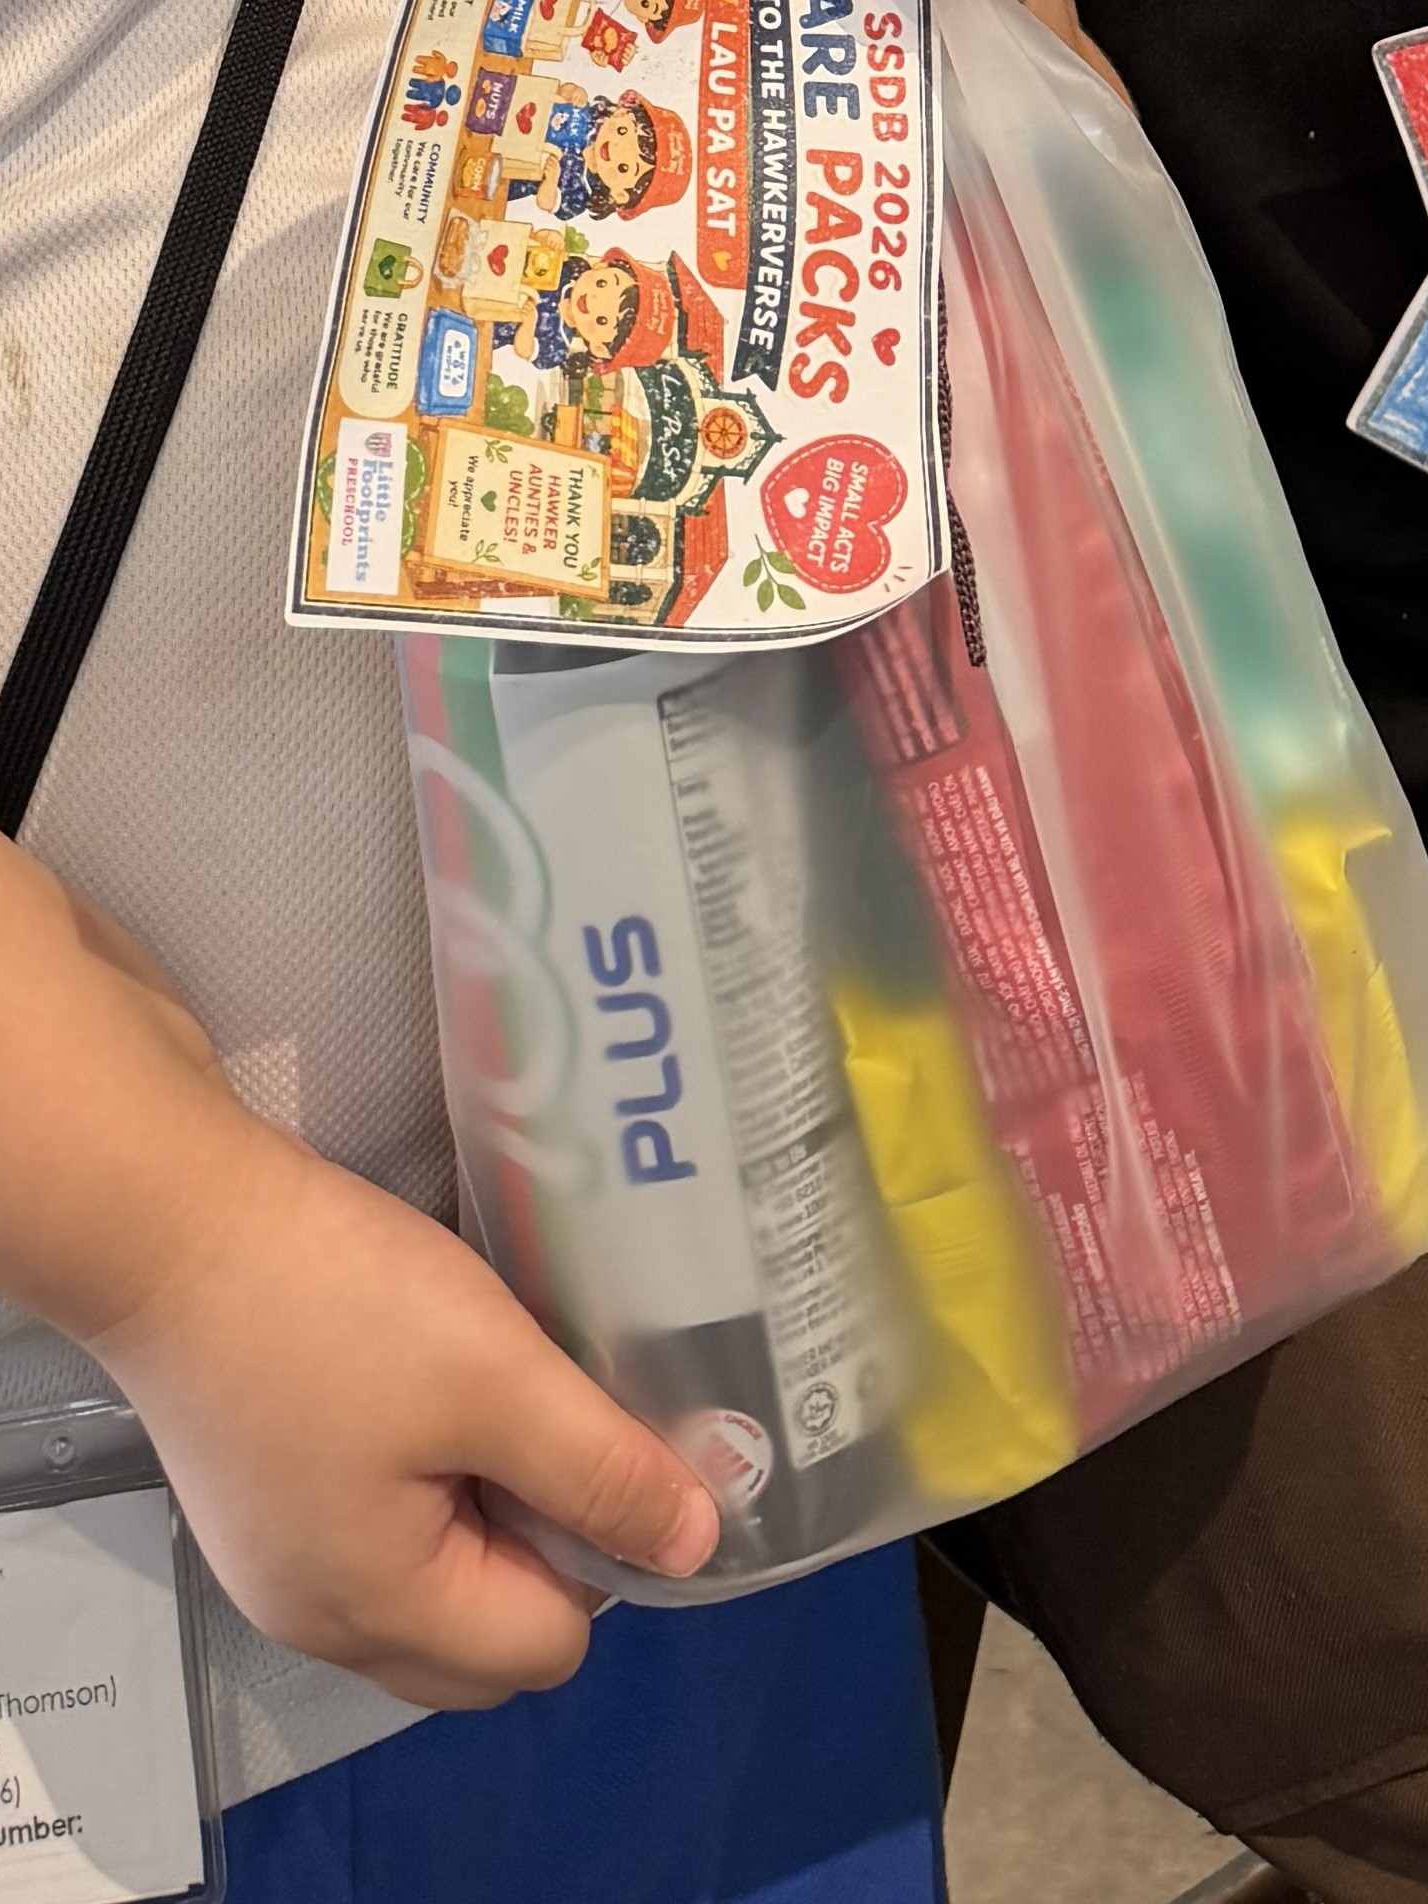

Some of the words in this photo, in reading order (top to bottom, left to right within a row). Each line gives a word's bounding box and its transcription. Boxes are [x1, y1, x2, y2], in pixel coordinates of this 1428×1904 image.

[706, 21, 738, 96] LAU
[758, 38, 785, 101] THE
[865, 9, 908, 144] SSDB
[486, 81, 504, 120] NUTS
[570, 108, 580, 136] MILK
[703, 106, 734, 157] PA
[416, 140, 427, 158] We
[470, 157, 485, 191] CORN
[407, 185, 417, 200] for
[416, 143, 441, 224] COMMUNITY
[702, 165, 735, 238] SAT
[748, 107, 788, 352] HAWKERVERSE
[865, 160, 912, 293] 2026
[787, 146, 866, 406] PACKS
[372, 310, 382, 325] for
[378, 331, 389, 349] are
[382, 311, 393, 329] We
[370, 350, 385, 395] grateful
[386, 312, 409, 390] GRATITUDE
[376, 459, 392, 523] Little
[448, 479, 459, 509] you!
[467, 454, 478, 474] We
[821, 457, 845, 493] BIG
[840, 461, 869, 524] SMALL
[342, 456, 357, 547] PRESCHOOL
[356, 457, 377, 583] Footprints
[460, 475, 475, 542] appreciate
[504, 468, 522, 544] UNCLES!
[525, 462, 541, 539] AUNTIES
[544, 473, 560, 551] HAWKER
[567, 467, 582, 529] THANK
[522, 542, 536, 556] &
[565, 532, 579, 571] YOU
[805, 494, 836, 568] IMPACT
[829, 525, 856, 574] ACTS
[584, 911, 697, 1187] PLUS
